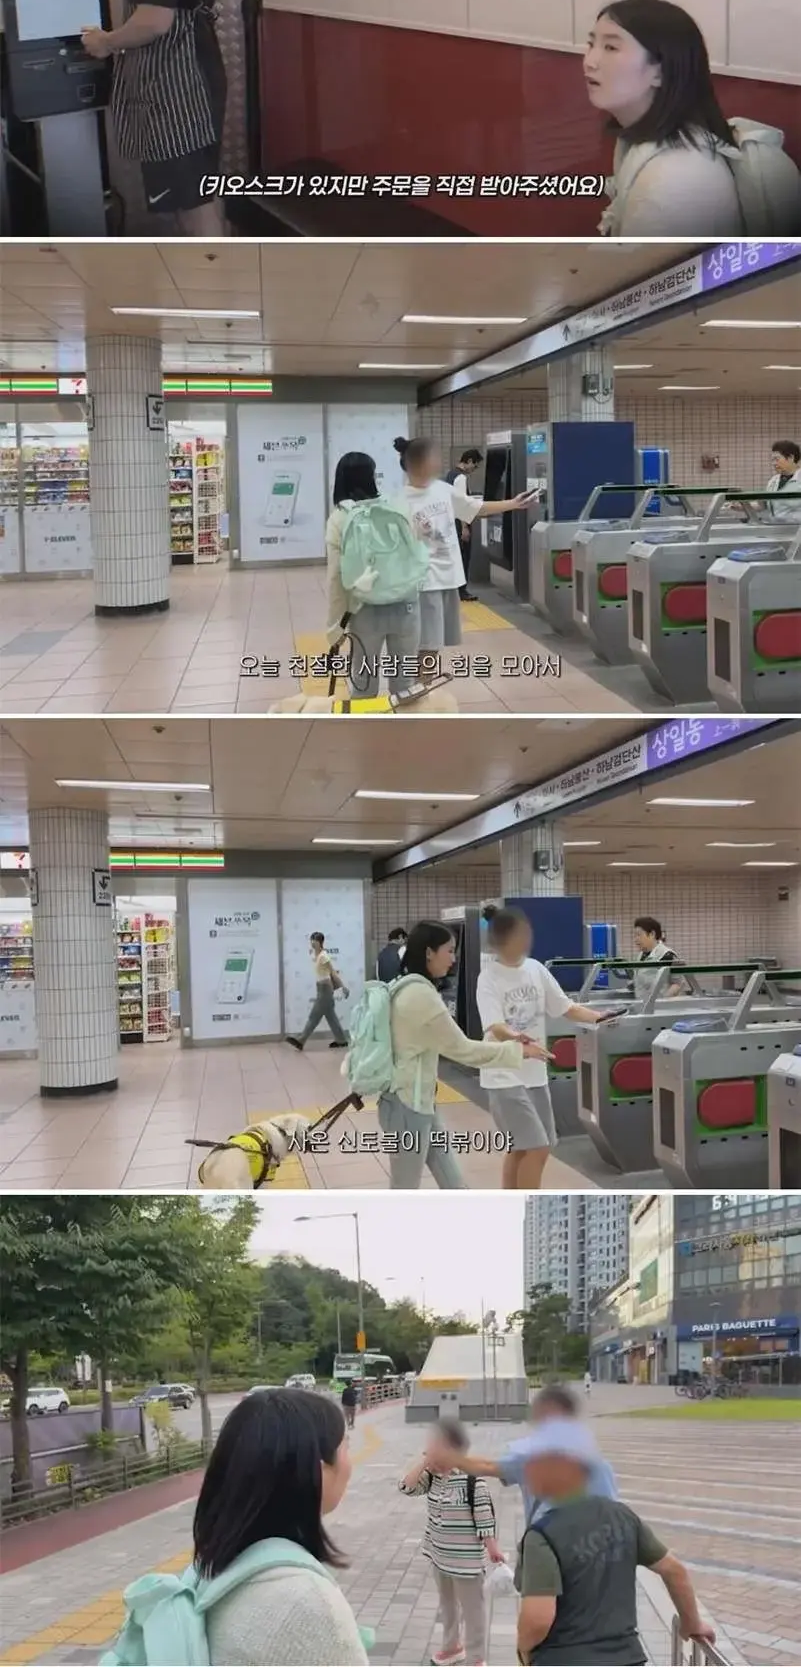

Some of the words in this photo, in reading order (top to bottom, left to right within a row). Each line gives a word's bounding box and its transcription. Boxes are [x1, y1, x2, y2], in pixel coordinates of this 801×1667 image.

[652, 719, 704, 758] 상일동
[596, 744, 642, 773] 하남검단산
[692, 1323, 720, 1332] PARIS
[722, 1318, 776, 1330] BAGUETTE
